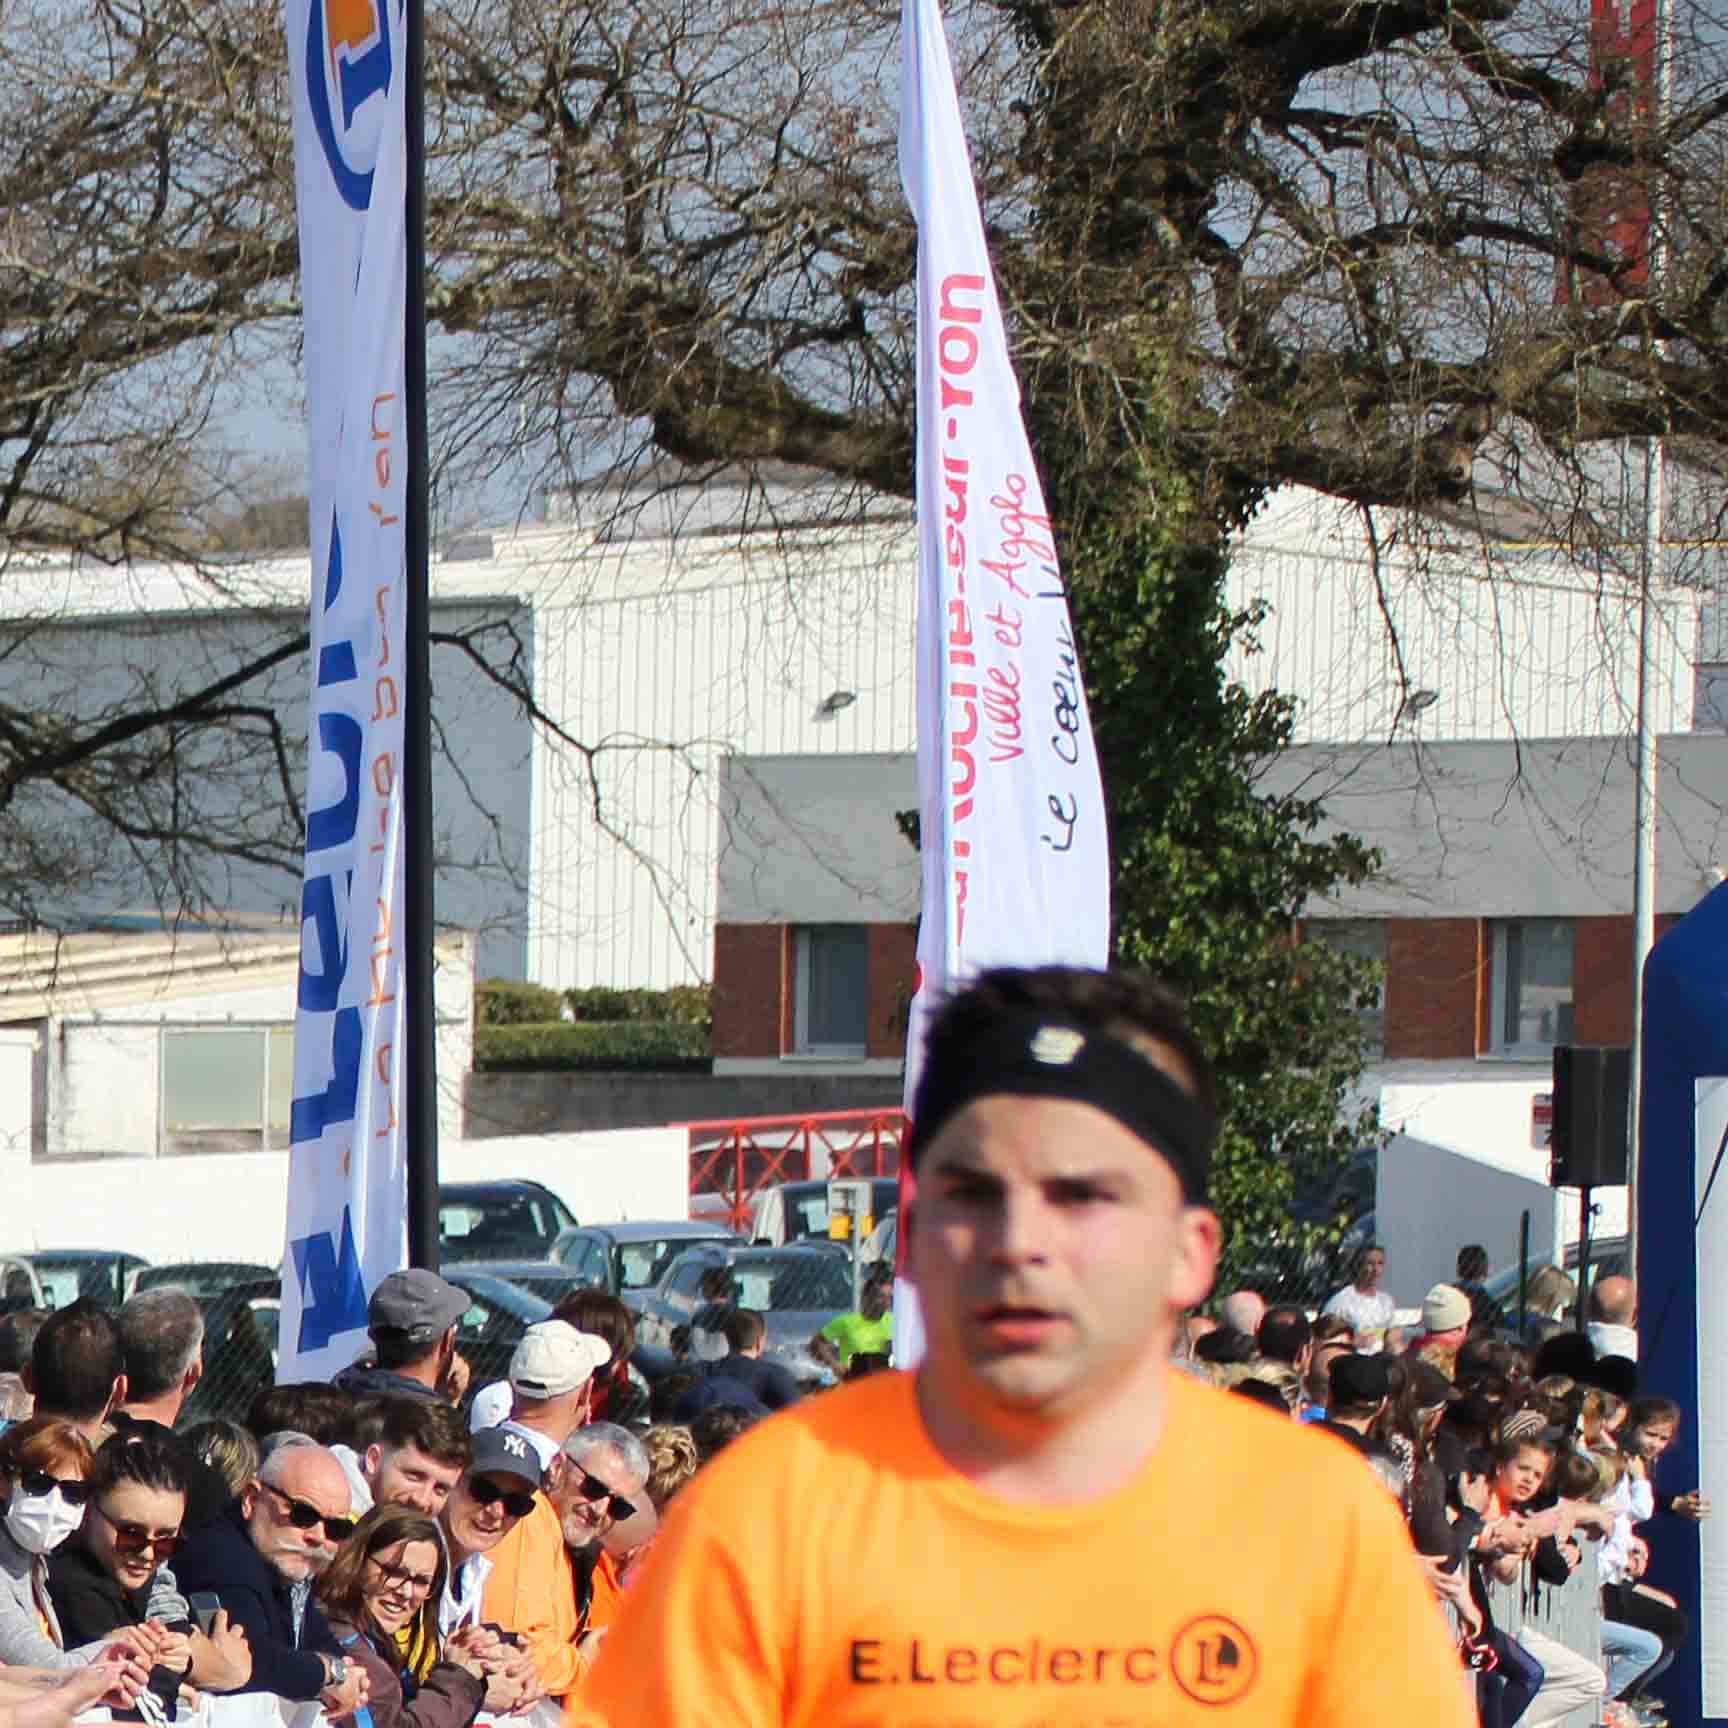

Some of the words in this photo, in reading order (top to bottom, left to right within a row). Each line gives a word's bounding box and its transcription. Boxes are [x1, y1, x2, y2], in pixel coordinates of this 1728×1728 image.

[994, 605, 1024, 653] et
[982, 650, 1025, 762] Ville
[850, 1638, 1161, 1685] E.Leclerc
